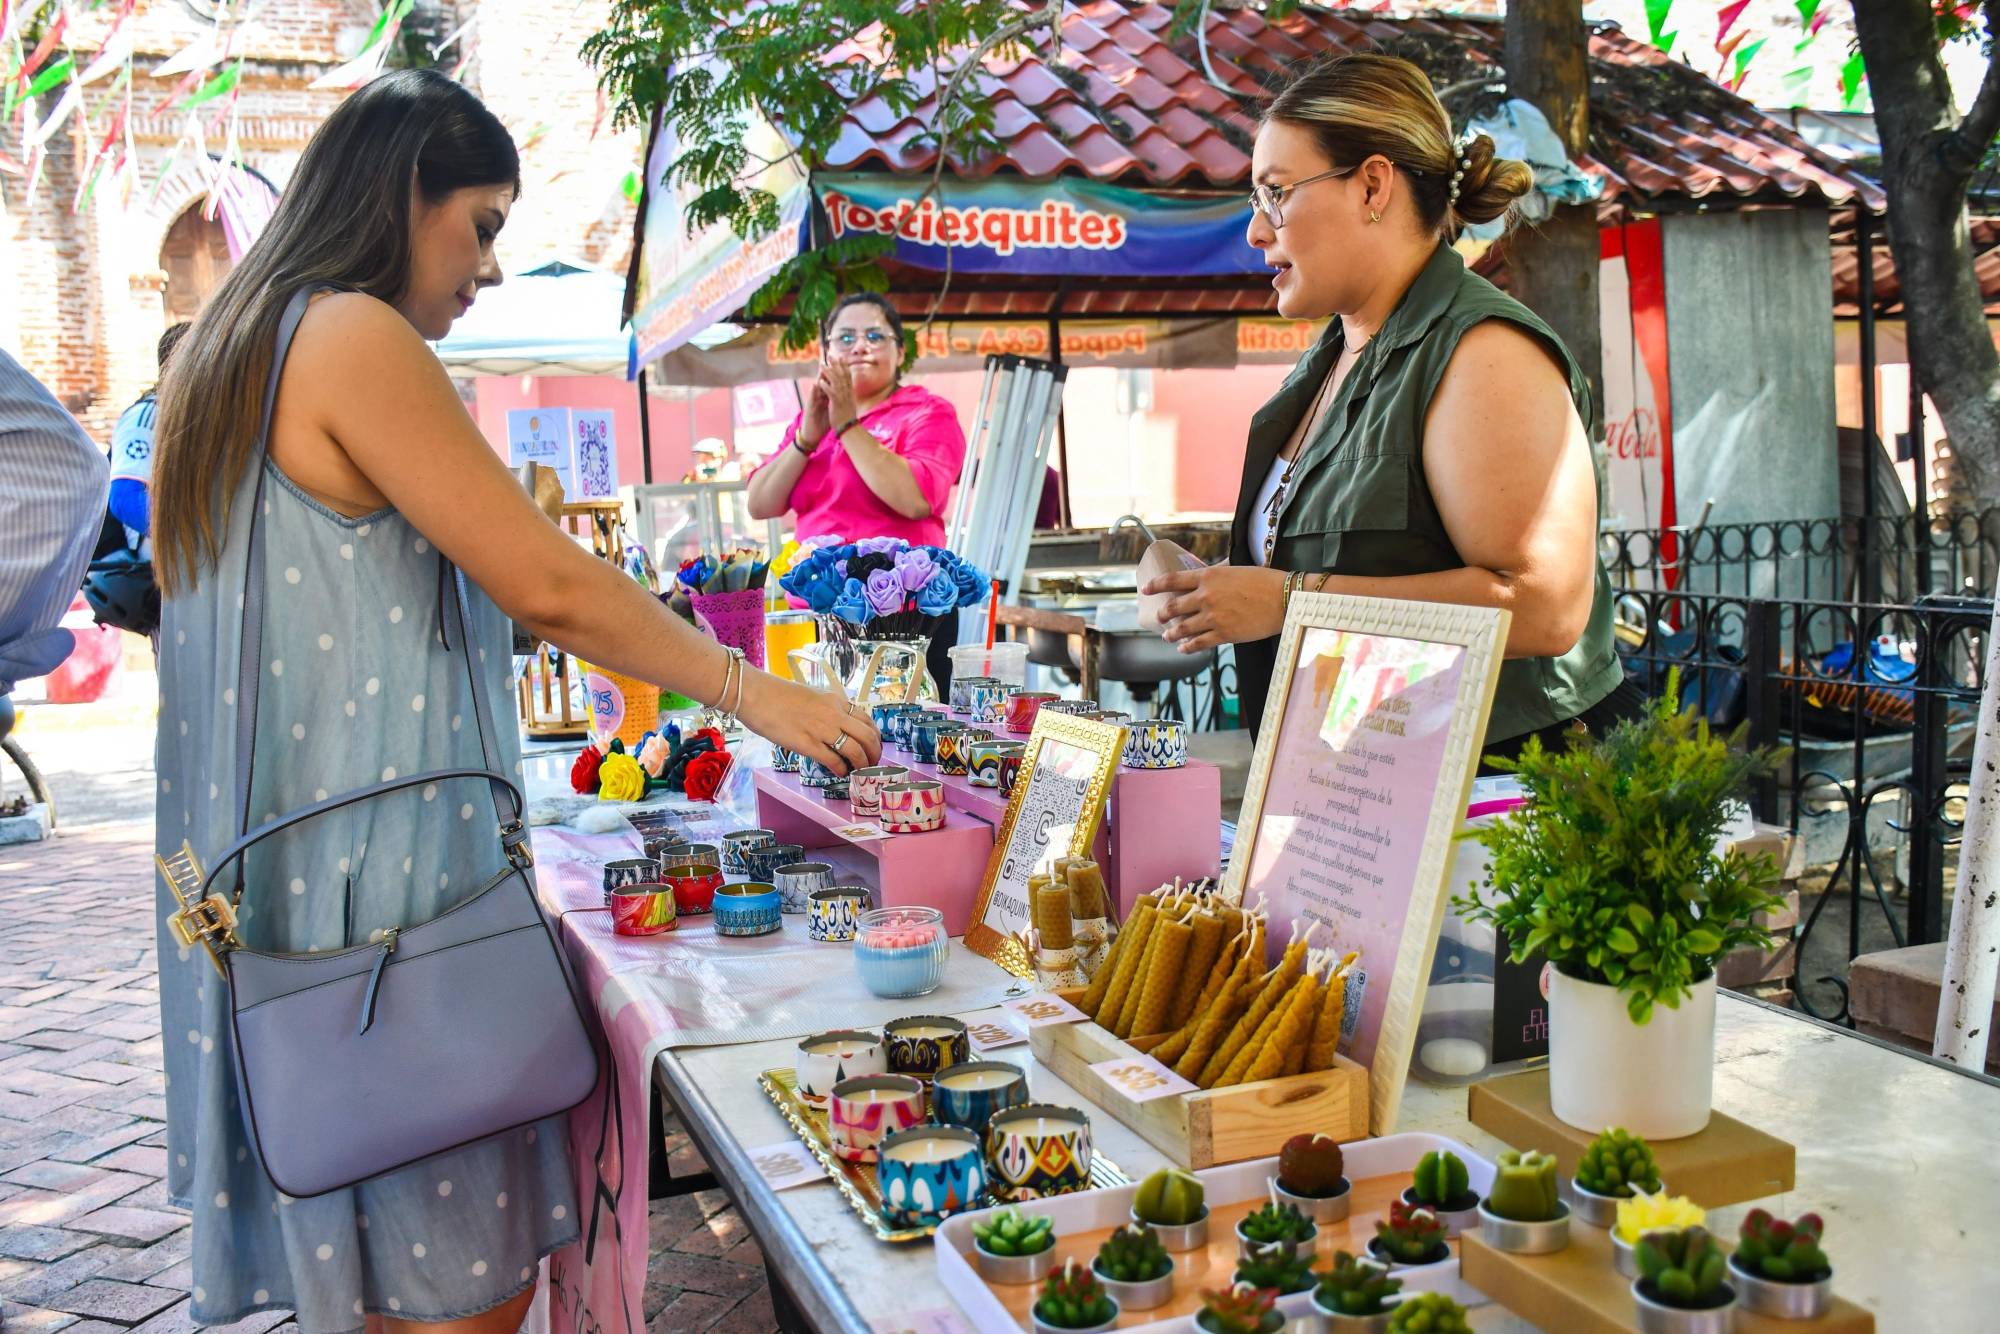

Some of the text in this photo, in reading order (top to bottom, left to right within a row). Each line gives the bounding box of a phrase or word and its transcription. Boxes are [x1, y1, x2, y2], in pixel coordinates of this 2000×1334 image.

[823, 191, 1123, 252] Tostiesquites
[1367, 752, 1379, 764] que
[1377, 786, 1385, 804] de
[1386, 788, 1393, 806] la
[1306, 812, 1320, 823] amor
[1384, 829, 1391, 847] la
[1315, 828, 1324, 844] del
[1324, 837, 1338, 849] amor
[1371, 874, 1384, 888] que
